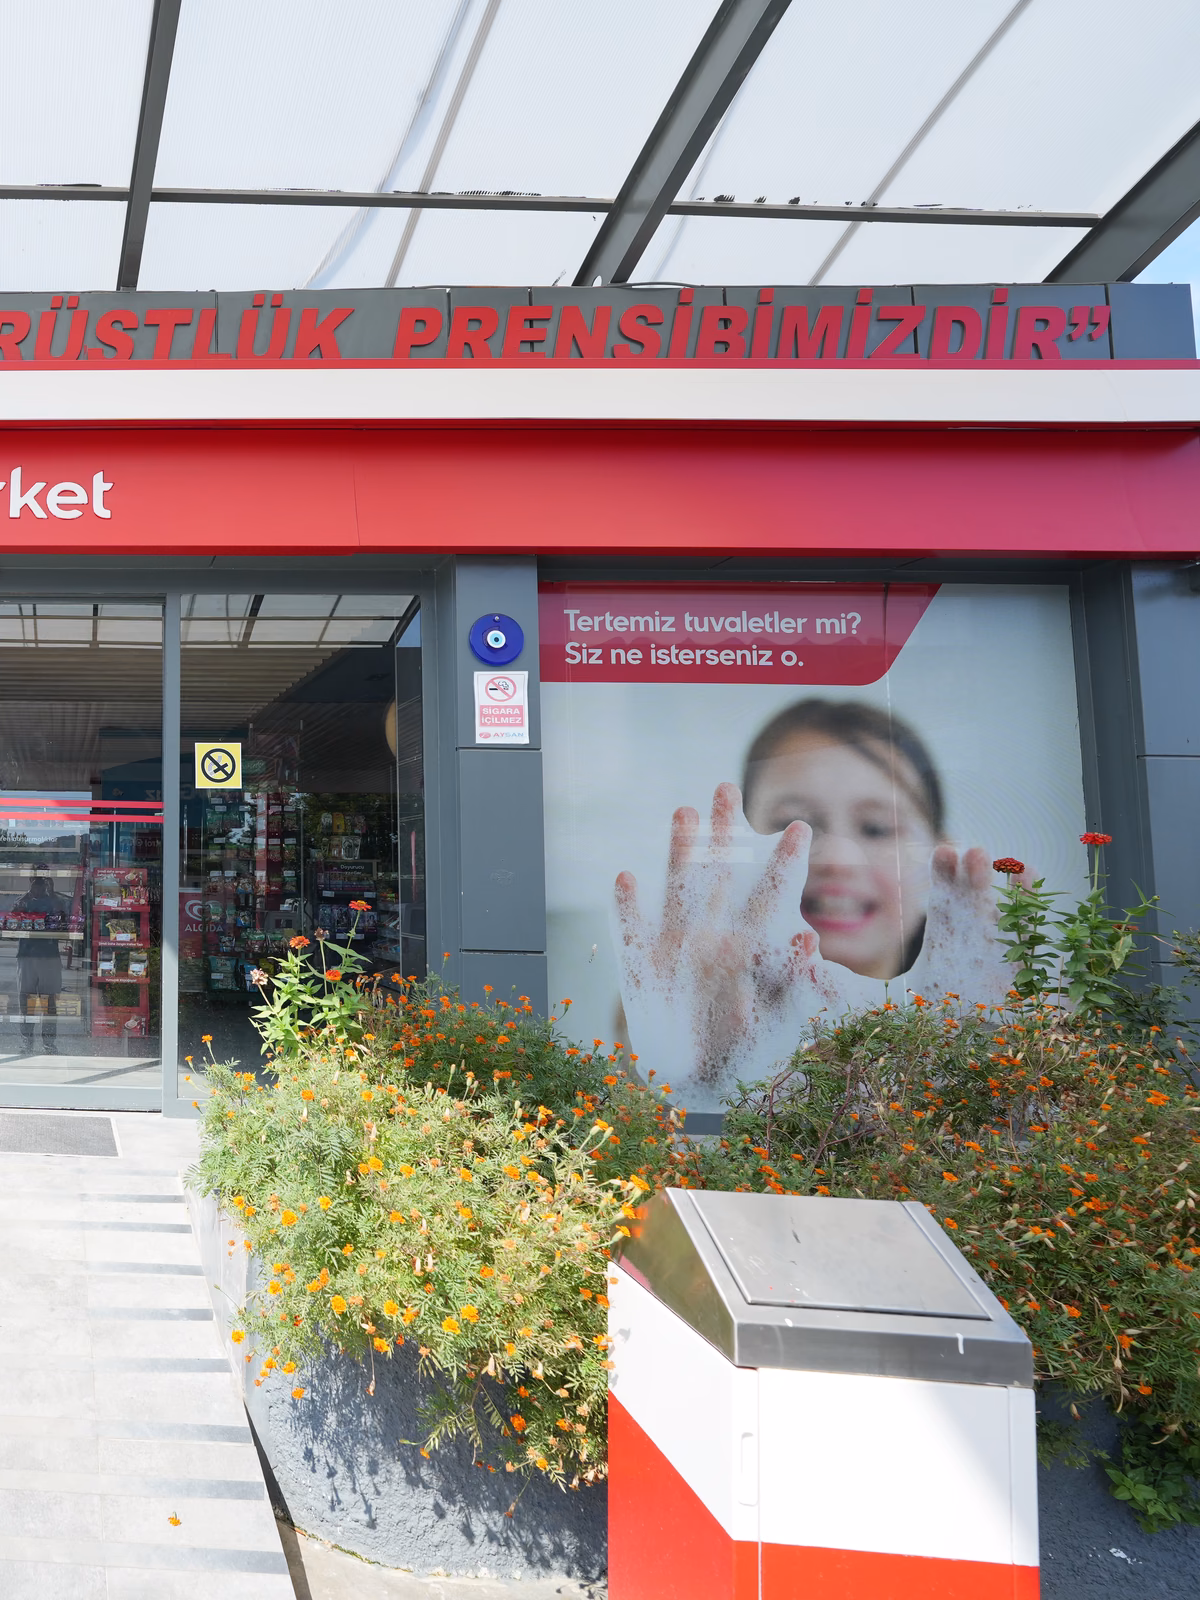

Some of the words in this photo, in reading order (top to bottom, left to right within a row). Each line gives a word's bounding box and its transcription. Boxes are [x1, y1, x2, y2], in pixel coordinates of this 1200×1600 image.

[564, 609, 676, 632] Tertemiz
[684, 610, 808, 634] tuvaletler
[815, 612, 862, 635] mi?
[564, 641, 603, 665] Siz
[610, 648, 643, 665] ne
[650, 644, 773, 666] isterseniz
[781, 650, 804, 667] o.
[482, 706, 520, 715] SİGARA
[481, 716, 522, 725] İÇİLMEZ
